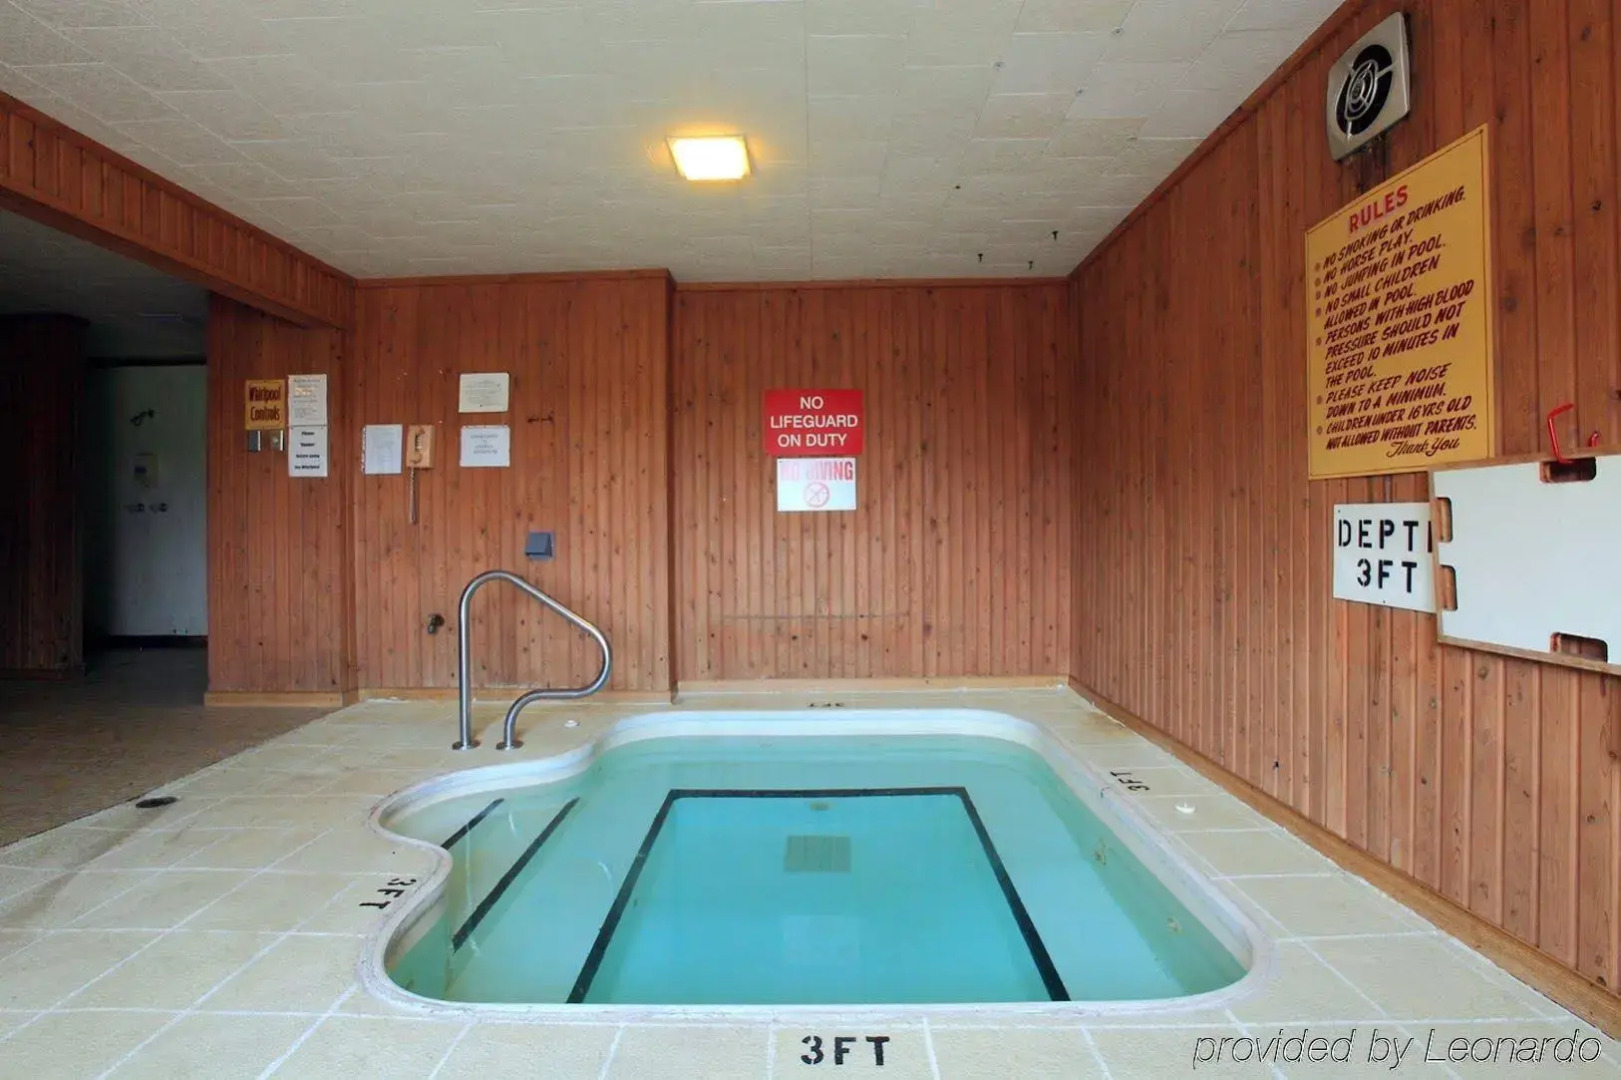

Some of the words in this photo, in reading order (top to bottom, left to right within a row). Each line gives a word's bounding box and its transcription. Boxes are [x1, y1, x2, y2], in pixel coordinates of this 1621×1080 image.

[1323, 253, 1336, 270] NO
[1338, 224, 1388, 261] SMOKING
[1390, 216, 1406, 233] OR
[1407, 185, 1466, 226] DRINKING.
[1349, 185, 1408, 233] RULES
[1324, 267, 1337, 283] NO
[1340, 247, 1375, 275] HORSE
[1378, 228, 1413, 256] PLAY.
[1325, 281, 1337, 298] NO
[1341, 257, 1388, 290] JUMPING
[1390, 250, 1406, 268] IN
[1408, 233, 1446, 260] POOL.
[1325, 297, 1340, 314] NO
[1340, 283, 1370, 307] SMALL
[1374, 254, 1441, 292] CHILDREN
[1324, 302, 1367, 330] ALLOWED
[1368, 296, 1380, 312] IN
[1384, 283, 1417, 306] POOL.
[1325, 316, 1370, 344] PERSONS
[1374, 304, 1406, 326] WITH
[1406, 293, 1434, 315] HIGH
[1435, 279, 1474, 306] BLOOD
[1325, 330, 1379, 360] PRESSURE
[1381, 312, 1432, 341] SHOULD
[1434, 300, 1466, 324] NOT
[1325, 352, 1364, 374] EXCEED
[1368, 347, 1380, 362] 10
[1382, 329, 1440, 358] MINUTES
[1442, 323, 1460, 340] IN
[249, 386, 280, 403] Whirlpool
[1326, 374, 1342, 389] THE
[1345, 366, 1376, 384] POOL.
[1326, 384, 1365, 404] PLEASE
[1367, 375, 1402, 394] KEEP
[1405, 362, 1452, 386] NOISE
[251, 406, 280, 421] Controls
[800, 396, 824, 410] NO
[1326, 402, 1356, 420] DOWN
[1358, 399, 1372, 412] TO
[1373, 396, 1381, 409] A
[1386, 382, 1447, 407] MINIMUM.
[1326, 414, 1374, 435] CHILDREN
[1372, 408, 1404, 426] UNDER
[1446, 395, 1472, 412] OLD
[770, 414, 858, 428] LIFEGUARD
[778, 434, 800, 447] ON
[806, 434, 847, 446] DUTY
[1326, 436, 1341, 450] NOT
[1341, 430, 1380, 448] ALLOWED
[1380, 422, 1424, 442] WITHOUT
[1424, 414, 1478, 436] PARENTS.
[1386, 439, 1428, 458] Thank
[1426, 437, 1460, 457] You
[1356, 558, 1418, 593] 3FT
[801, 1035, 890, 1066] 3FT
